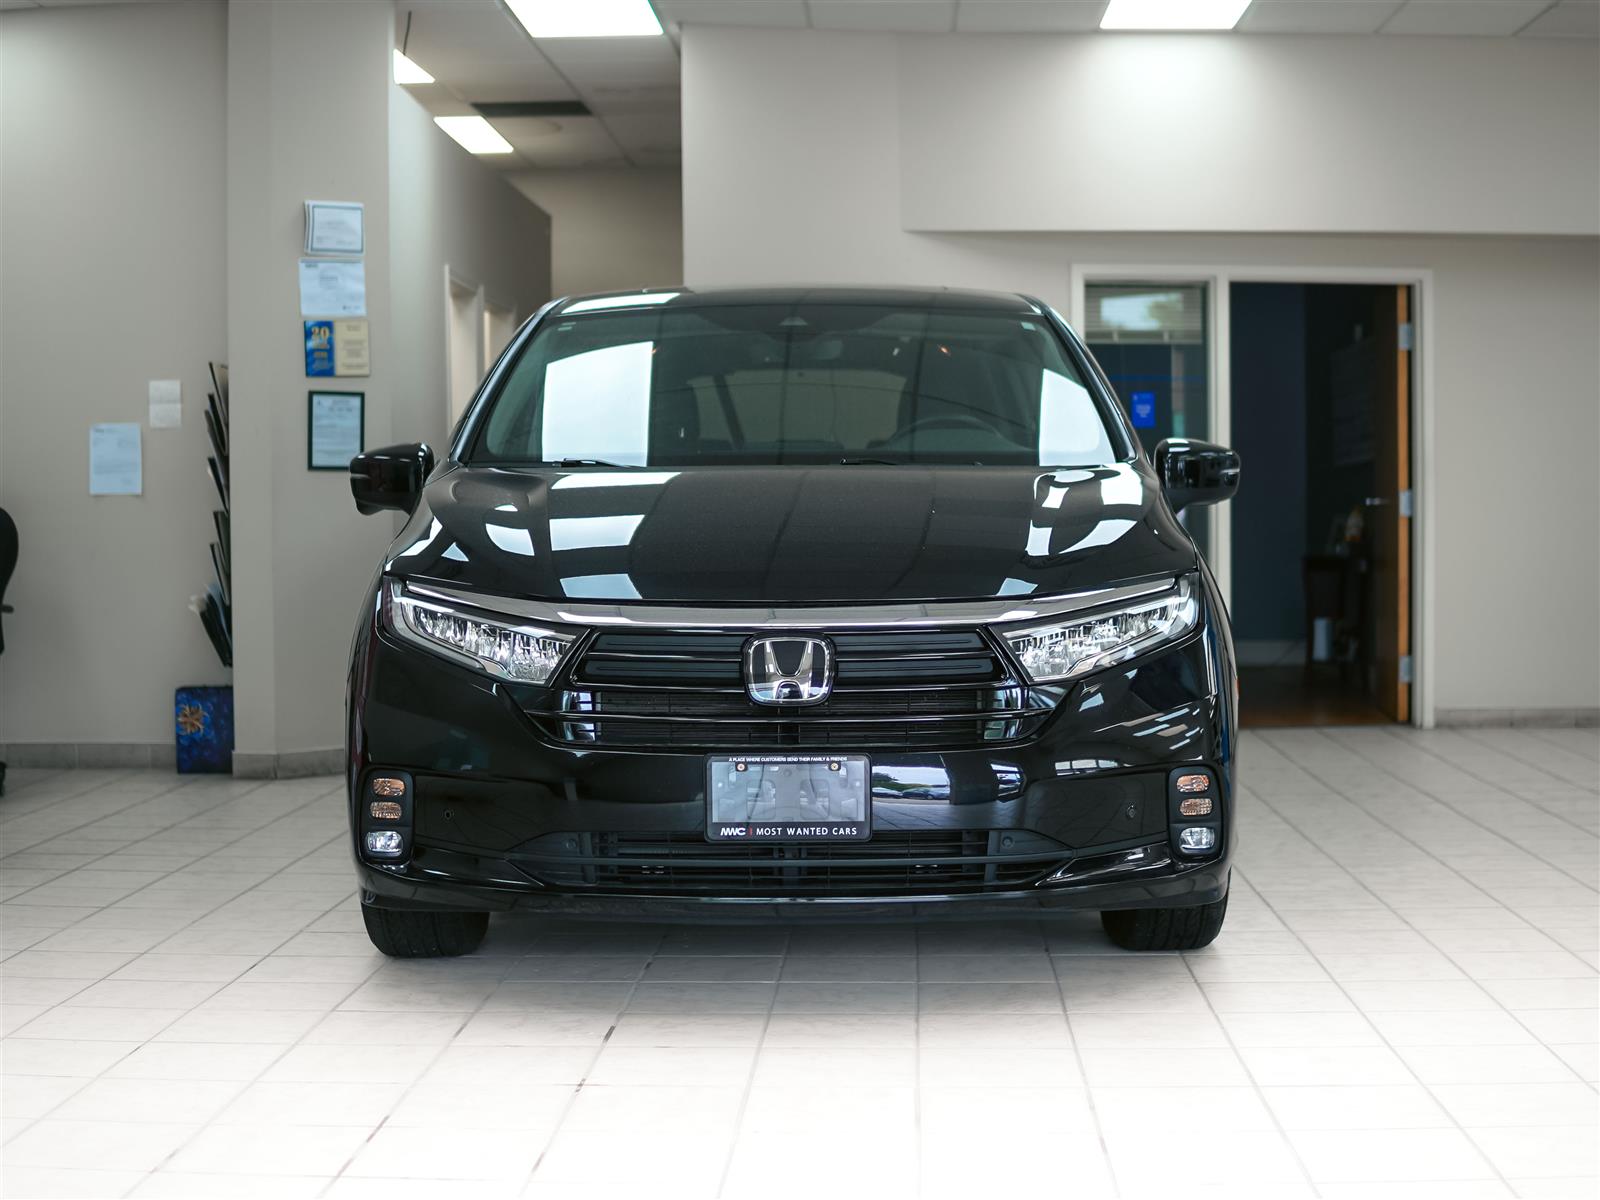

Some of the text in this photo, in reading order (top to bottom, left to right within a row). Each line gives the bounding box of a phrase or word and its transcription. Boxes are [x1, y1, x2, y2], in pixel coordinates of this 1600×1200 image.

[756, 827, 782, 836] MOST
[787, 827, 829, 836] WANTED
[832, 827, 857, 836] CARS
